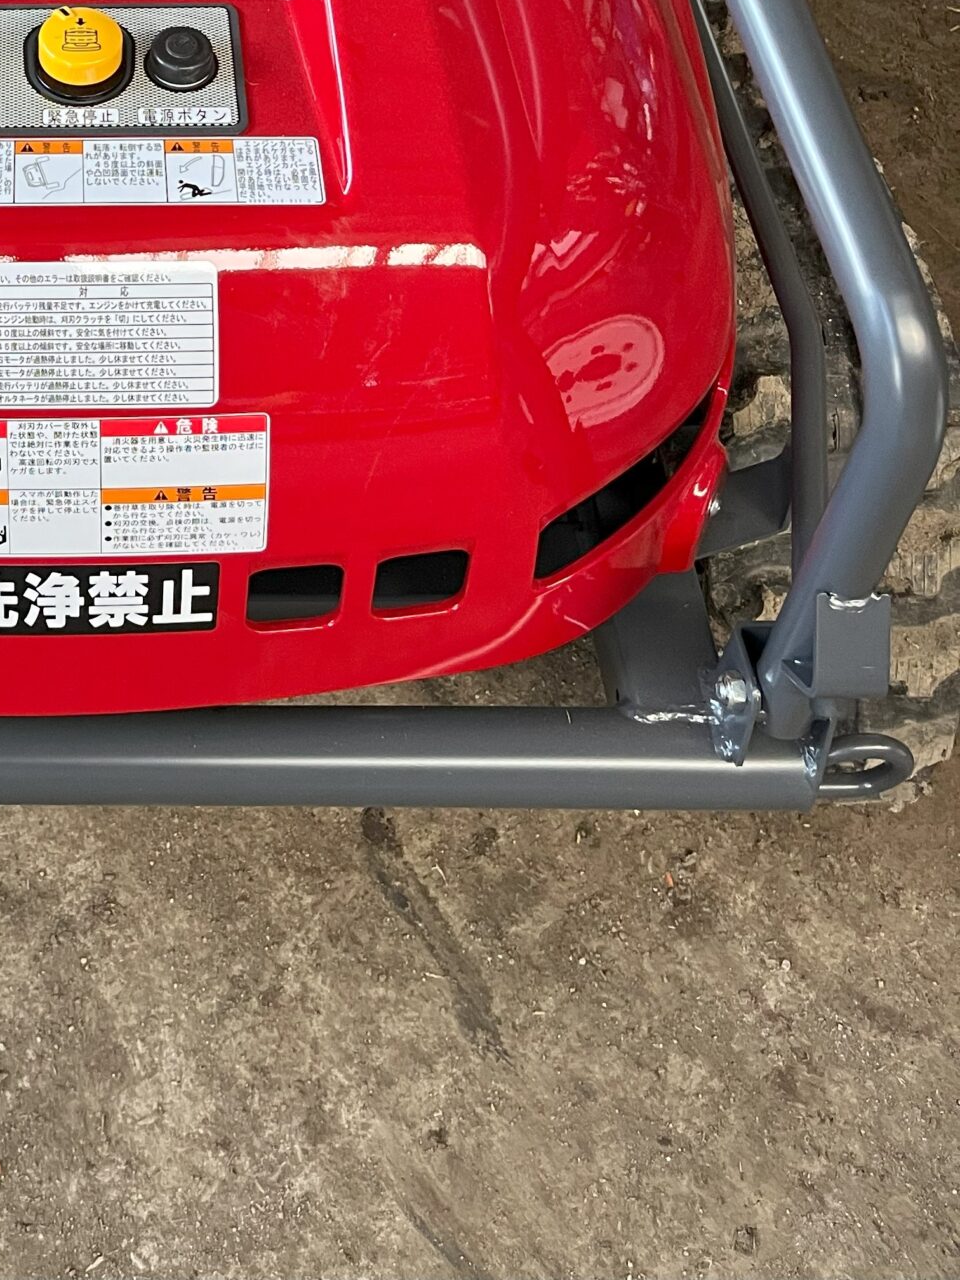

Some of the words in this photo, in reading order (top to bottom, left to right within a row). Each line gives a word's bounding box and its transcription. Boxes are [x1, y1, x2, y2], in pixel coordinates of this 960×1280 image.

[47, 109, 115, 124] 緊急停止
[142, 108, 228, 123] 電源ボタン
[42, 142, 71, 153] 警告
[192, 141, 219, 153] 警告
[79, 286, 129, 298] 対応
[176, 417, 218, 434] 危険
[176, 487, 217, 502] 警告
